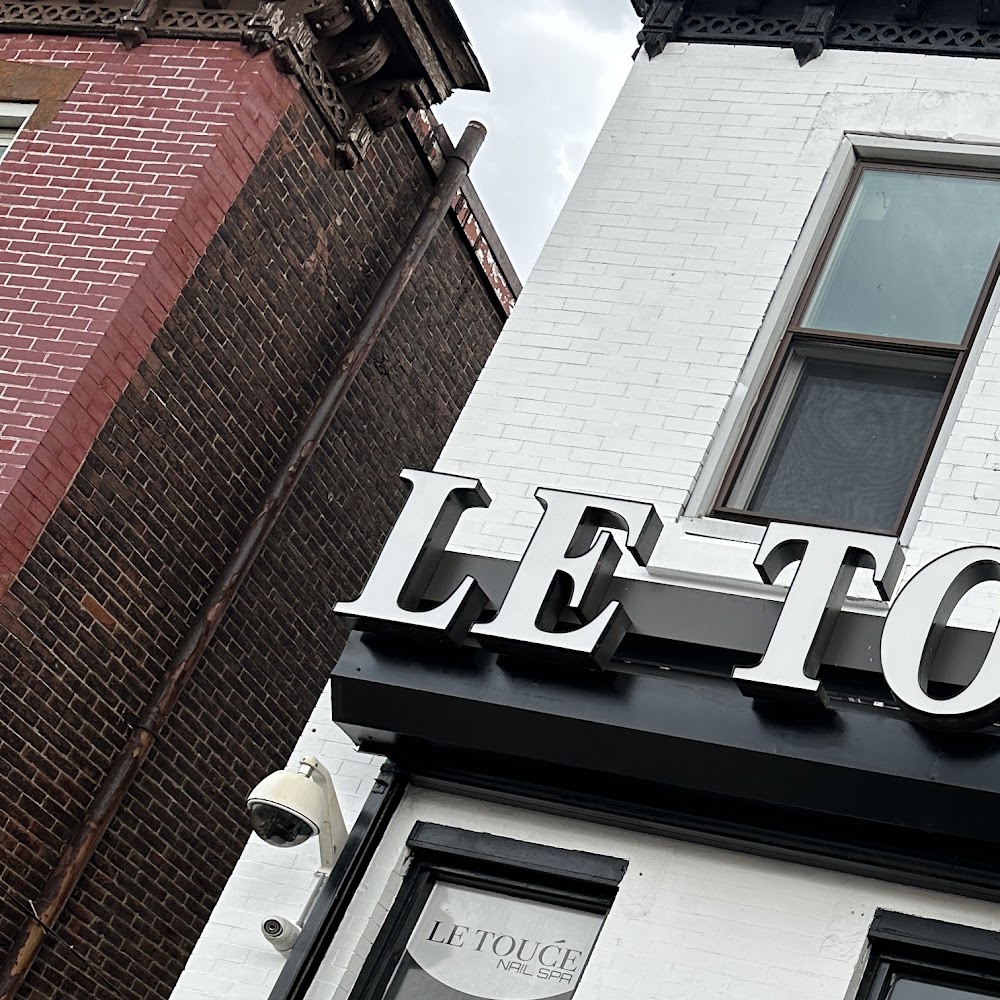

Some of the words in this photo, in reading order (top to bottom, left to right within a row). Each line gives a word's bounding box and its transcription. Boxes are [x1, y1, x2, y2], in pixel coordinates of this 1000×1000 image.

[332, 468, 660, 658] LE
[426, 919, 470, 948] LE
[496, 958, 533, 977] NAIL
[537, 967, 573, 985] SPA
